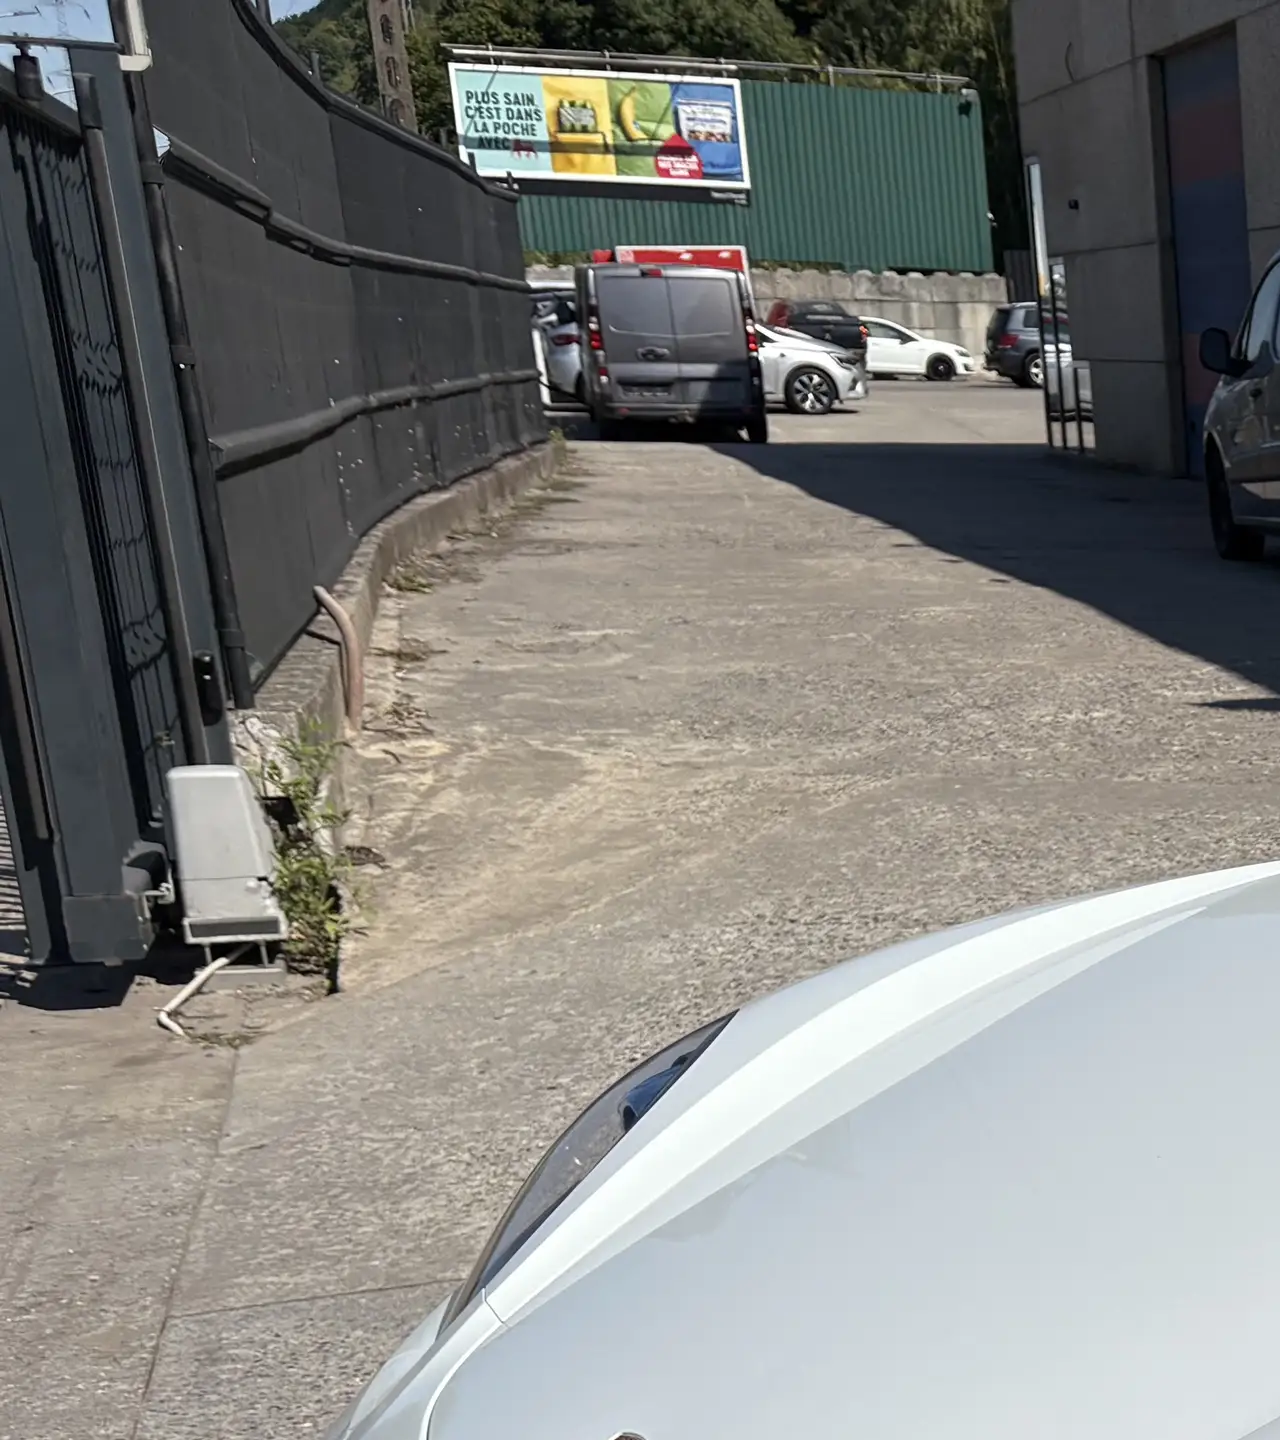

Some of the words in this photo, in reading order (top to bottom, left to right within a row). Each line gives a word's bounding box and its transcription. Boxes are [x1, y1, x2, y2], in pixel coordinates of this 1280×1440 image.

[465, 90, 499, 105] PLUS
[465, 105, 502, 120] C'EST
[506, 107, 543, 121] DANS
[473, 120, 490, 133] LA
[493, 121, 538, 136] POCHE
[479, 136, 511, 150] AVEC
